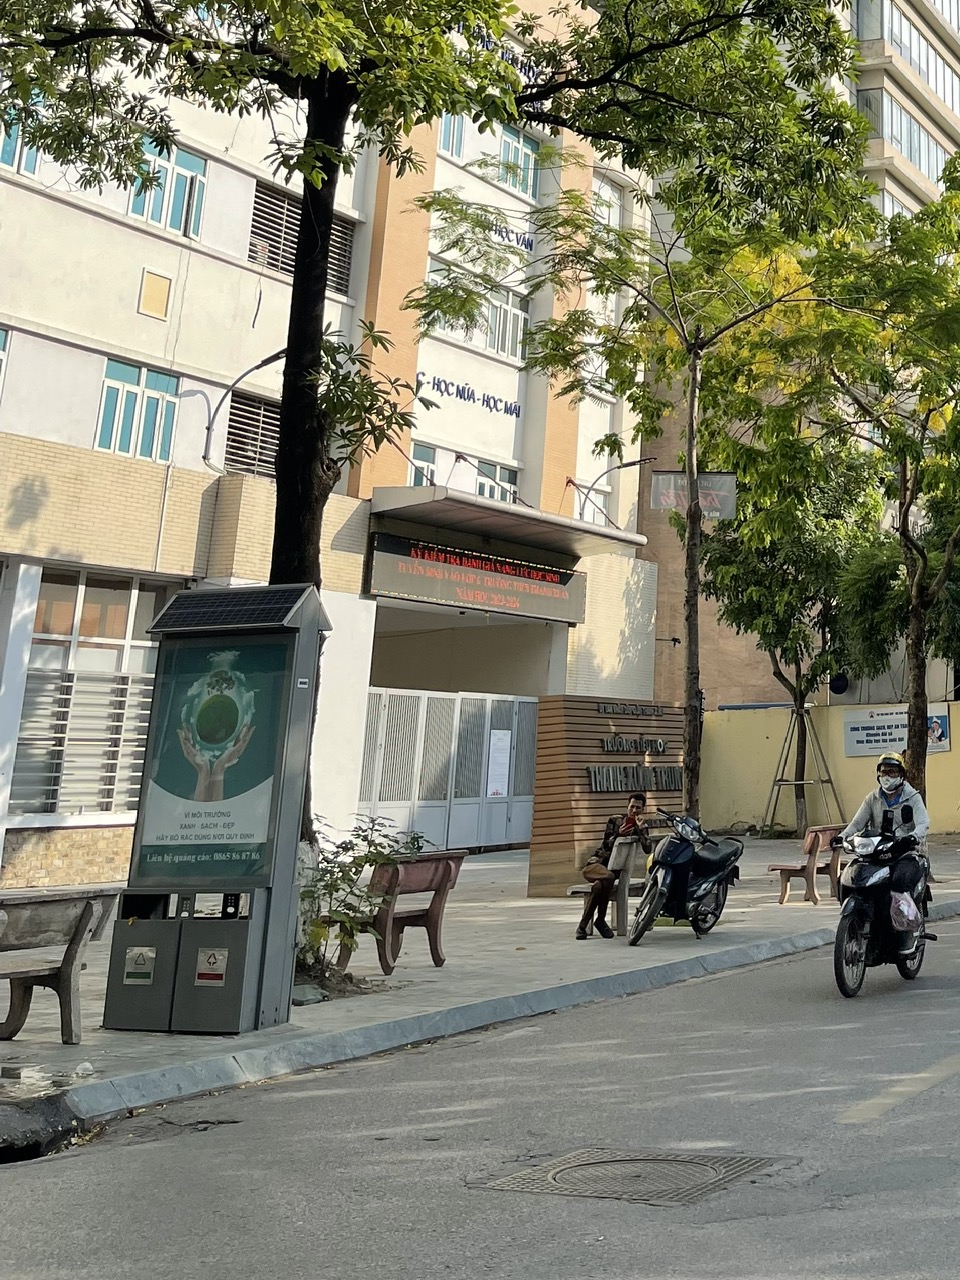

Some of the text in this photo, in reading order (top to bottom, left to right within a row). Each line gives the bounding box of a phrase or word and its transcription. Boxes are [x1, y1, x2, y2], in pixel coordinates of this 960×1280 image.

[432, 376, 455, 397] HỌC
[482, 393, 503, 413] HỌC
[226, 832, 238, 840] QUY
[232, 852, 240, 860] 86
[242, 852, 250, 860] 87
[251, 852, 260, 860] 86
